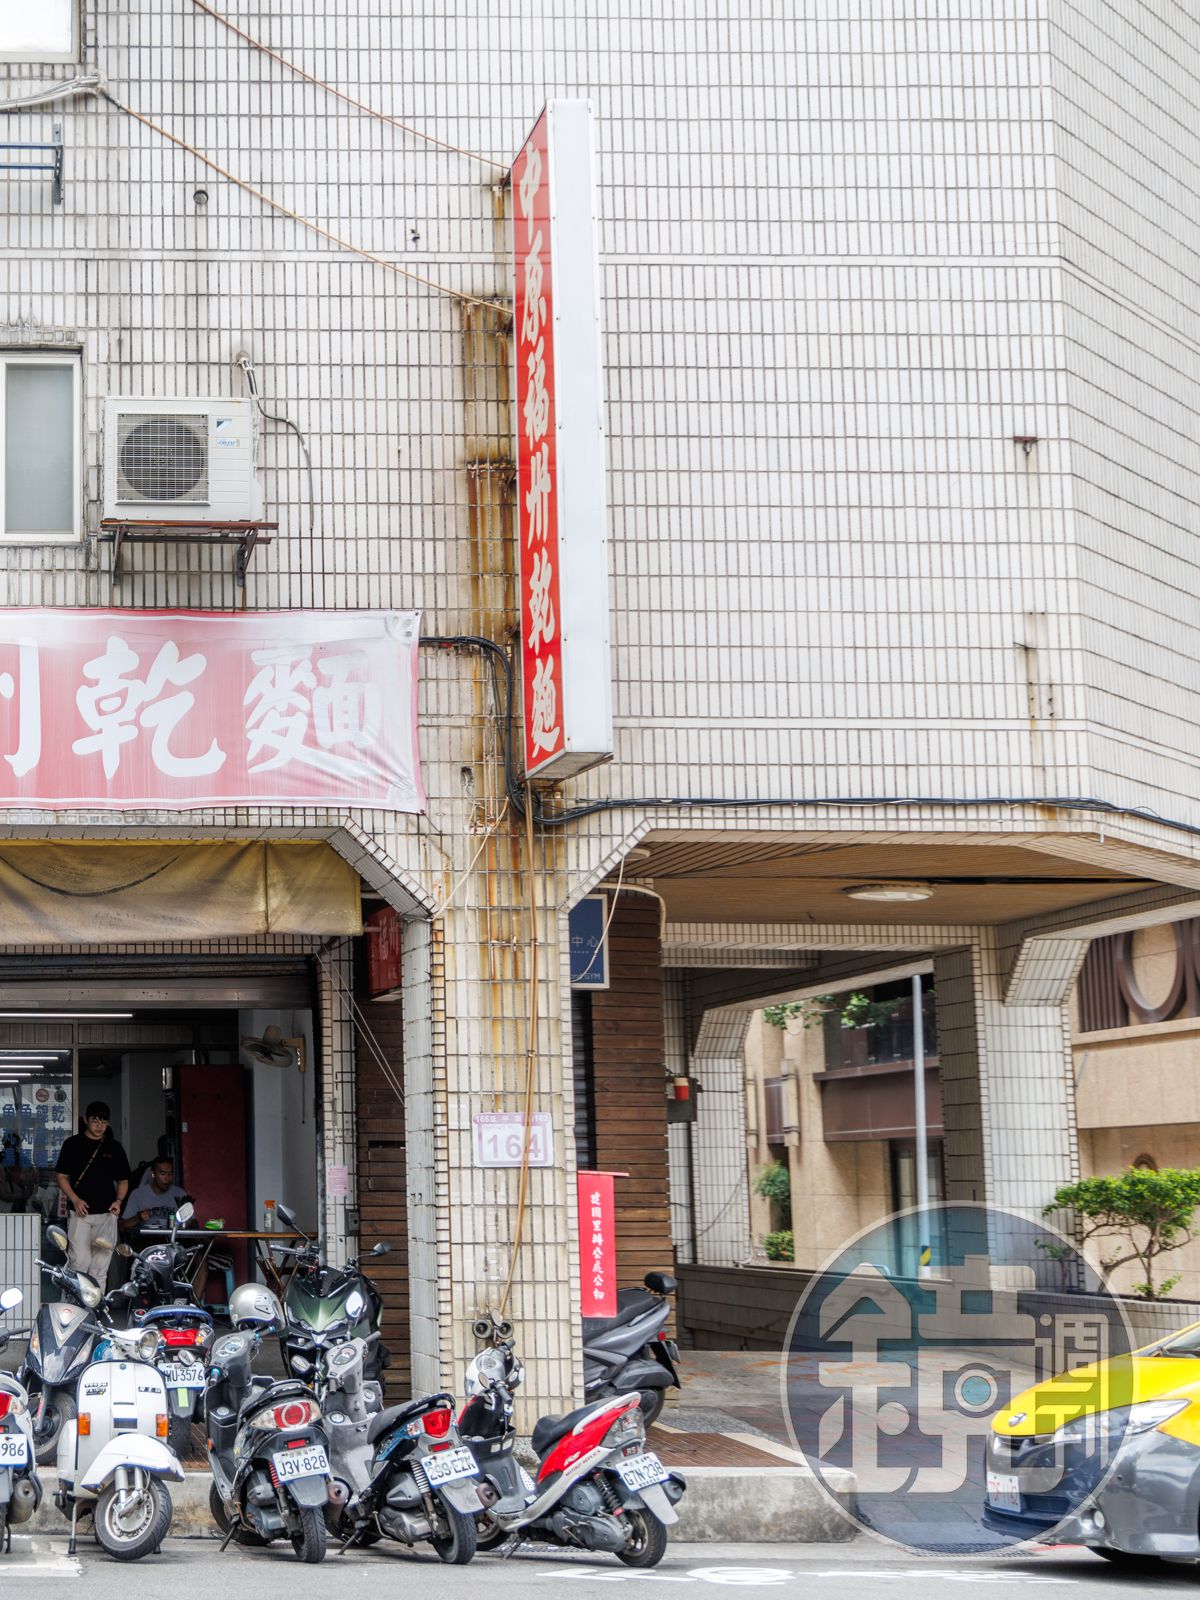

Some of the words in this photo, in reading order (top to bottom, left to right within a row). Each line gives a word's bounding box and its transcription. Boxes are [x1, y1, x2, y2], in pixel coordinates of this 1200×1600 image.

[520, 140, 560, 757] 中原福州乾麵
[487, 1134, 542, 1159] 164
[164, 1368, 204, 1384] WU-3576
[280, 1455, 327, 1477] J3V-828
[623, 1461, 665, 1486] G7N-238
